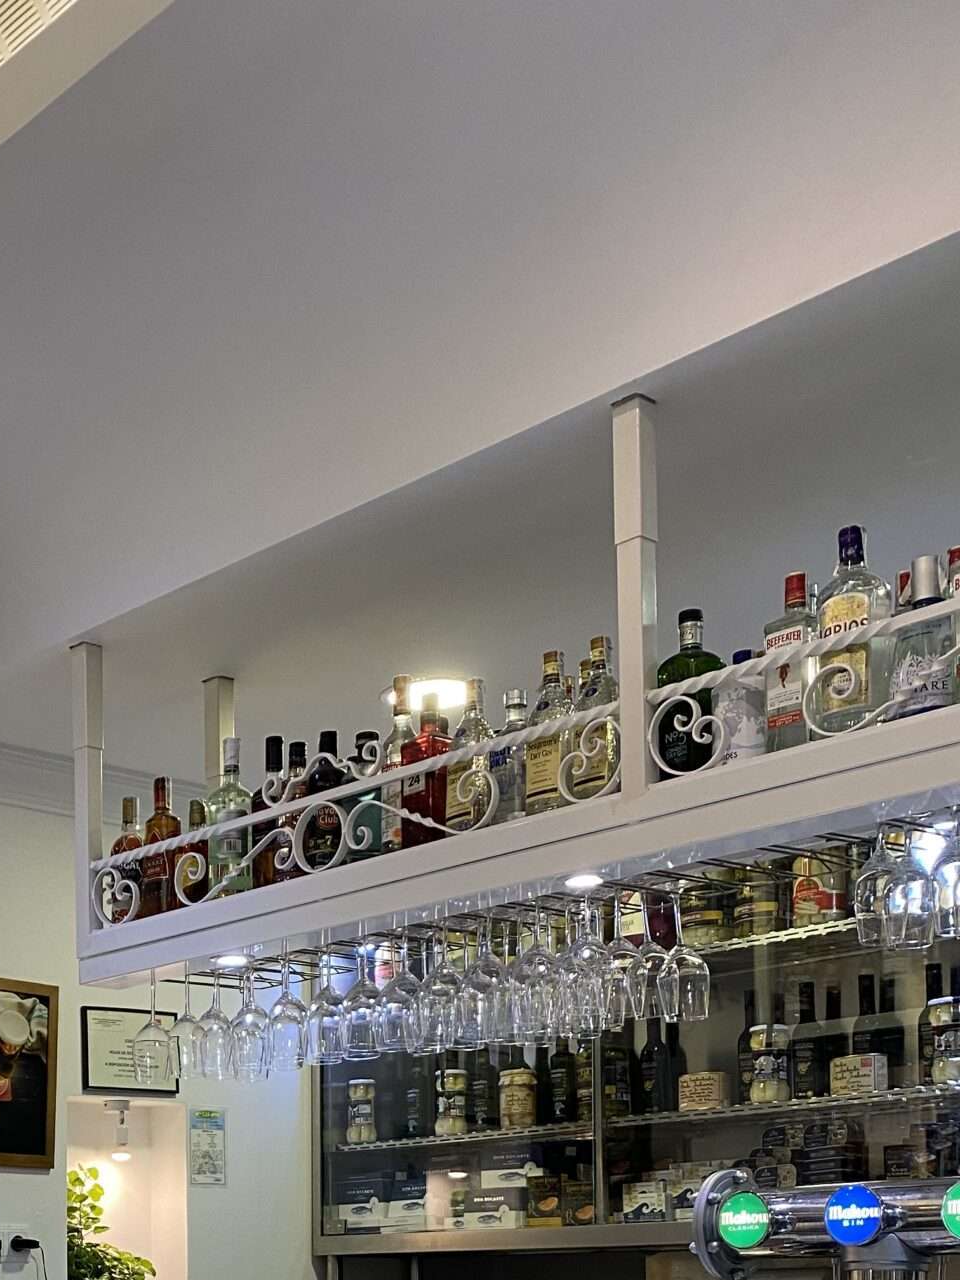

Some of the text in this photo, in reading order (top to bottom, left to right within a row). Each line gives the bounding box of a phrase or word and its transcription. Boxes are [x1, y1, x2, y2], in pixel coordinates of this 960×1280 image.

[766, 629, 802, 650] BEEFEATER
[408, 774, 421, 787] 24
[319, 814, 338, 825] Club
[721, 1210, 769, 1226] Mahou
[828, 1203, 880, 1220] Mahou
[842, 1219, 864, 1227] SIN
